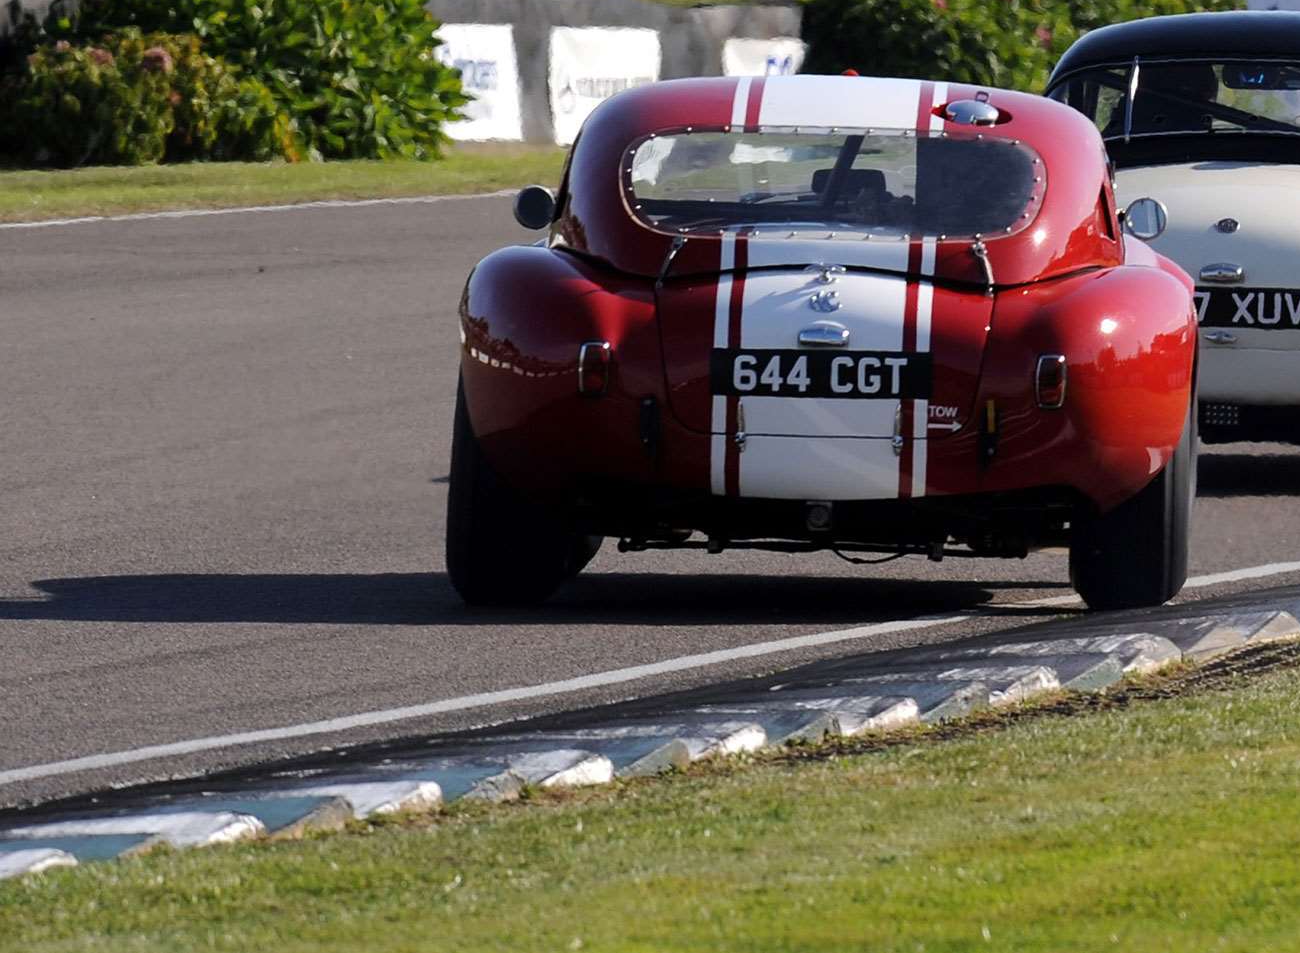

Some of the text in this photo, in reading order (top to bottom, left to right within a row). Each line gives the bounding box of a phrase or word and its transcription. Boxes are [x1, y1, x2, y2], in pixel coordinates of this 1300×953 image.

[733, 355, 908, 394] 644 CGT
[929, 405, 958, 418] TOW
